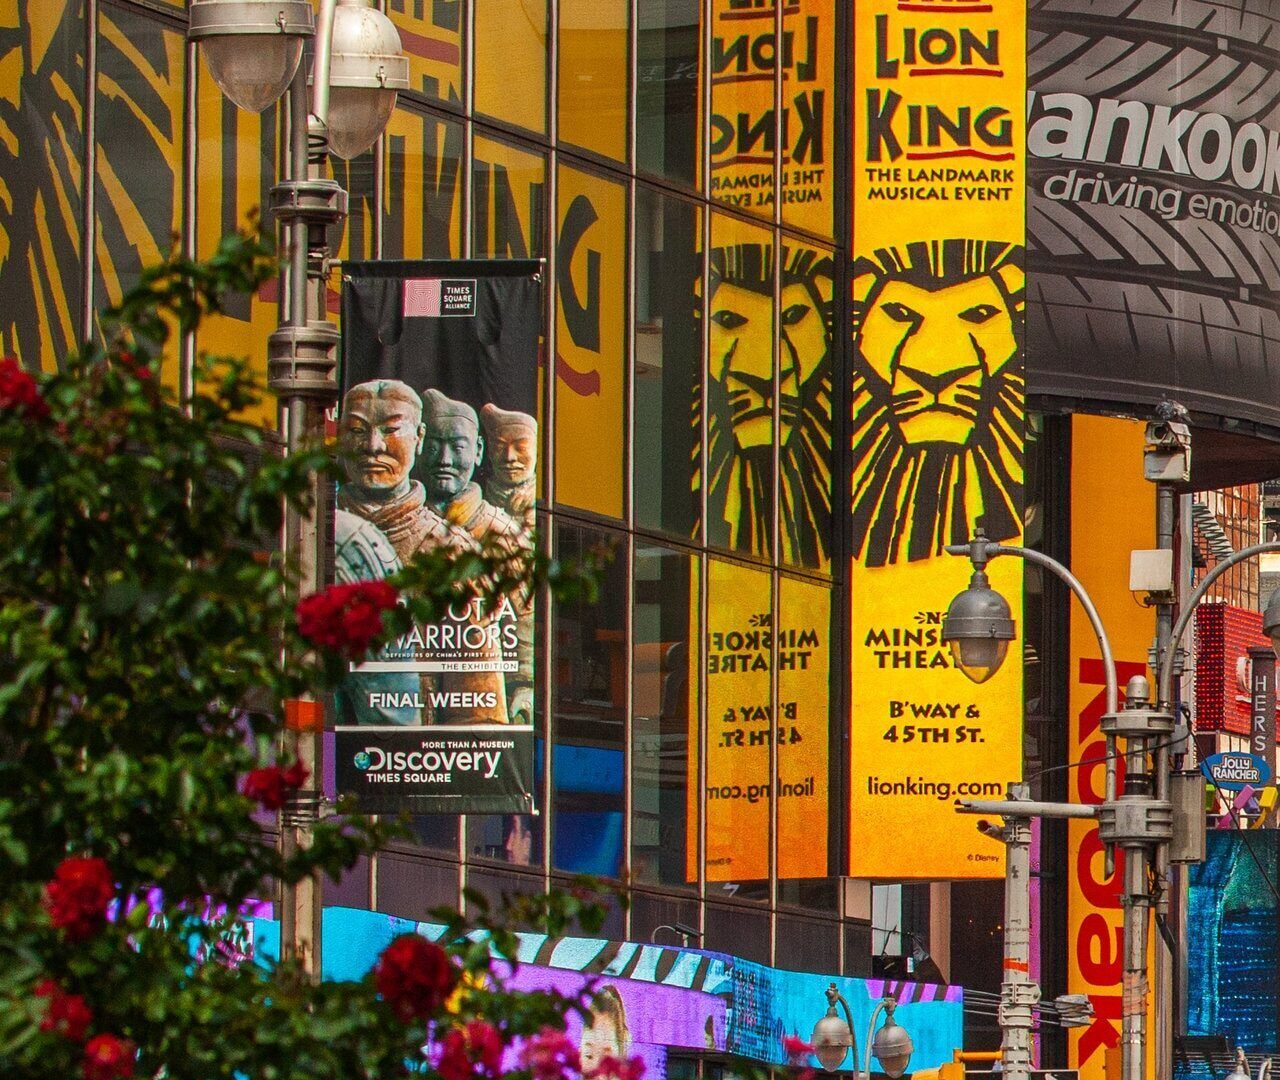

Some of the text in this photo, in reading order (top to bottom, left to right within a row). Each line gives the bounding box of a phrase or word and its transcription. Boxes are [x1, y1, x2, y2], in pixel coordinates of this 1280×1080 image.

[875, 13, 1000, 79] LION
[866, 88, 1014, 162] KING
[865, 167, 1015, 183] THE LANDMARK
[867, 187, 1013, 201] MUSICAL EVENT
[1043, 169, 1183, 221] driving
[446, 286, 470, 295] TIMES
[443, 294, 472, 303] SQUARE
[441, 663, 517, 671] THE EXHIBITION
[369, 692, 497, 708] FINAL WEEKS
[889, 701, 980, 719] B'WAY &
[883, 726, 985, 743] 45TH ST.
[422, 741, 515, 749] MORE THAN A MUSEUM
[1221, 756, 1250, 771] JOLLY
[366, 773, 452, 783] TIMES SQUARE
[1212, 767, 1260, 782] RANCHER
[867, 776, 1003, 800] lionking.com
[975, 854, 1000, 863] Disney
[1077, 658, 1148, 1069] Kodak
